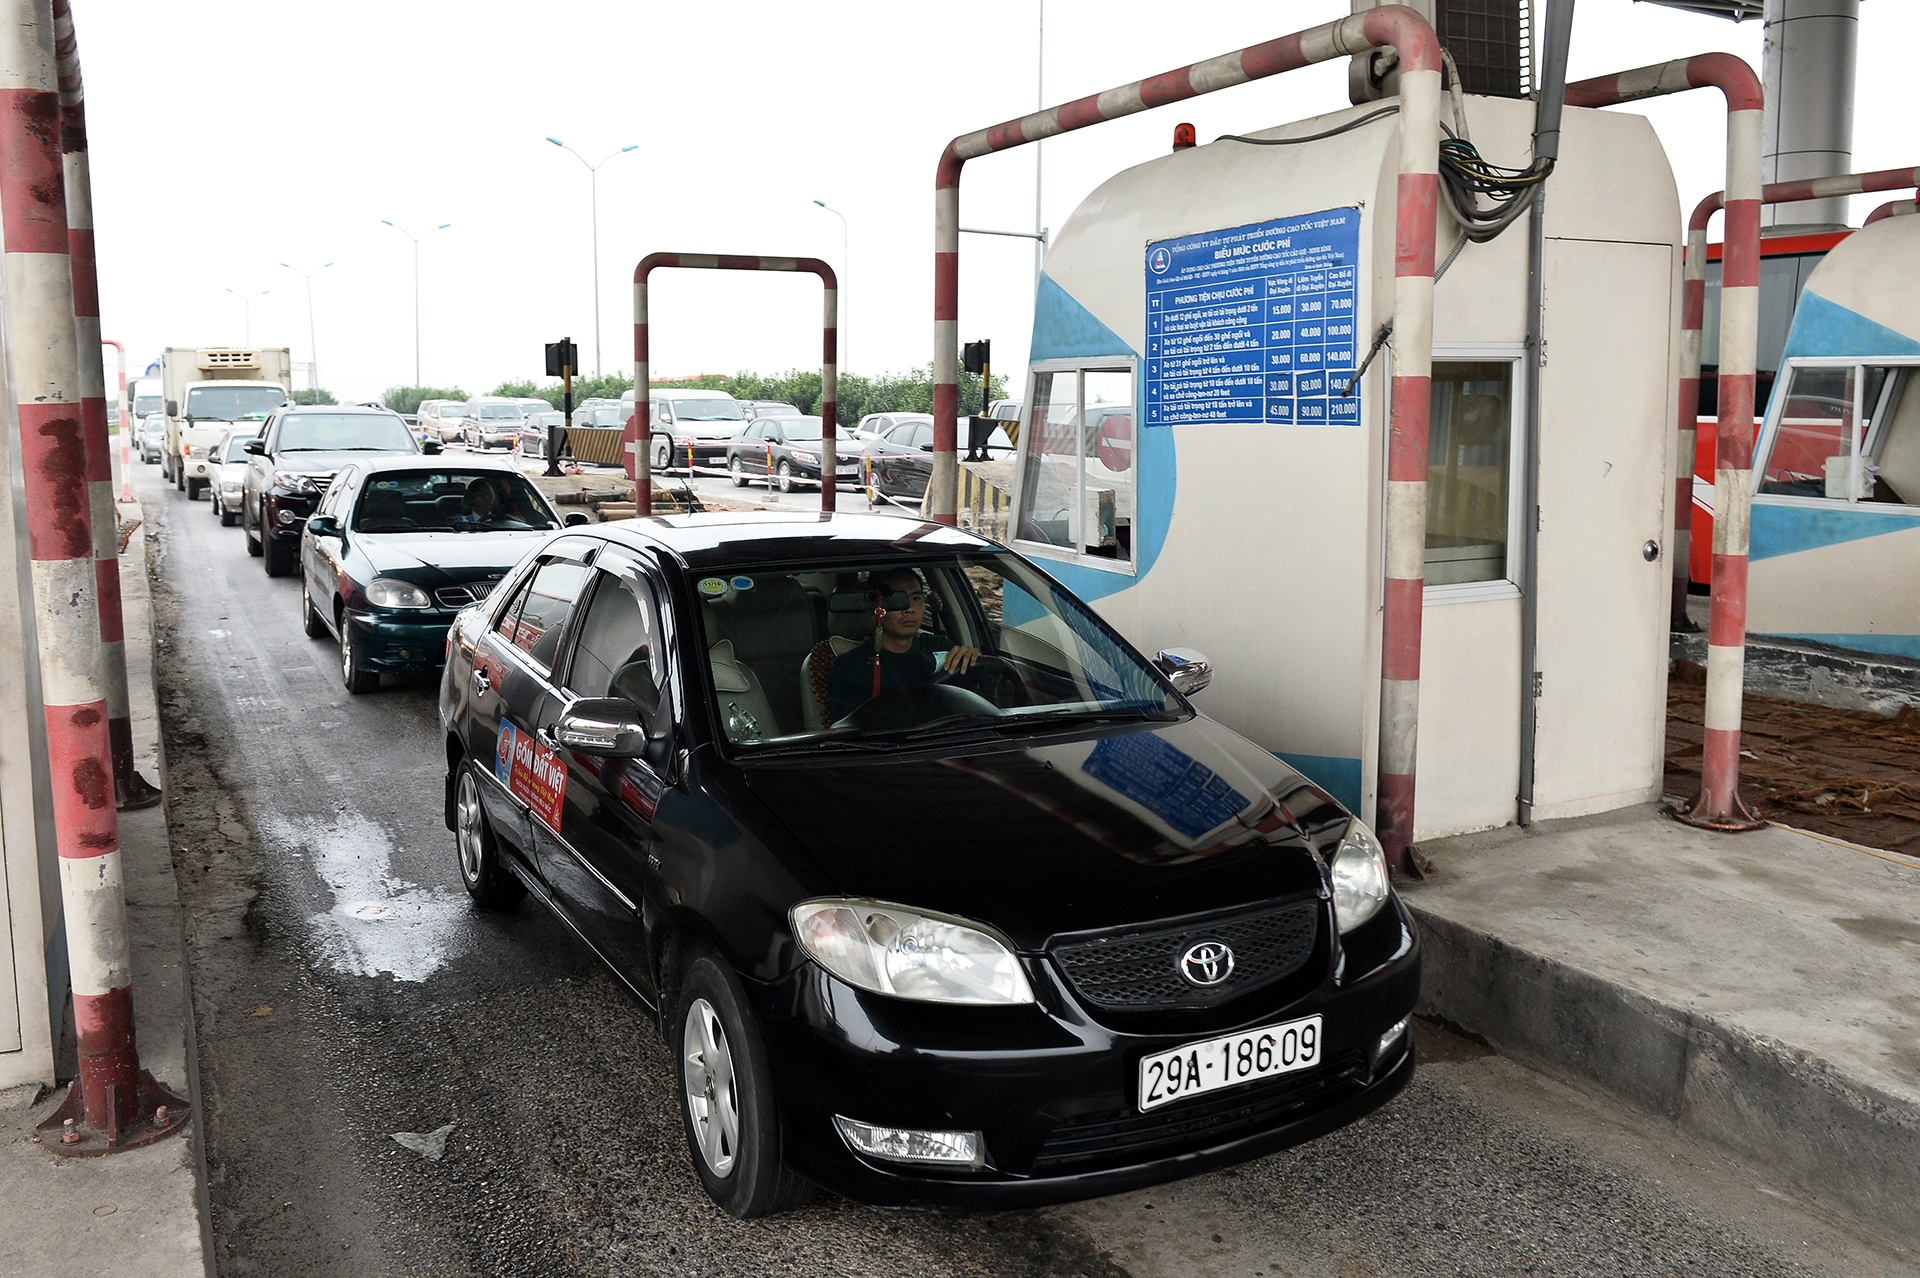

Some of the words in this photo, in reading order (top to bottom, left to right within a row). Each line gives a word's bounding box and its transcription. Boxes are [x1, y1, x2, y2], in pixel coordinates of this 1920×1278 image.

[1215, 245, 1231, 259] BIỂU
[1233, 244, 1251, 256] MỨC
[1253, 240, 1275, 252] CƯỚC
[1277, 236, 1291, 249] PHÍ
[1301, 301, 1321, 312] 30.000
[1331, 298, 1352, 309] 70.000
[1273, 304, 1291, 315] 15.000
[1272, 330, 1291, 340] 20.000
[1301, 327, 1321, 337] 40.000
[1328, 325, 1351, 335] 100.000
[1272, 354, 1290, 364] 30.000
[1300, 353, 1320, 362] 60.000
[1327, 351, 1351, 361] 140.000
[1270, 380, 1289, 391] 30.000
[1301, 378, 1322, 391] 60.000
[1270, 405, 1289, 416] 45.000
[1302, 406, 1322, 416] 90.000
[1331, 403, 1356, 414] 210.000
[516, 740, 532, 770] GỐM
[534, 754, 548, 781] ĐẤT
[549, 766, 564, 798] VIỆT
[1147, 1024, 1316, 1102] 29A-186.09
